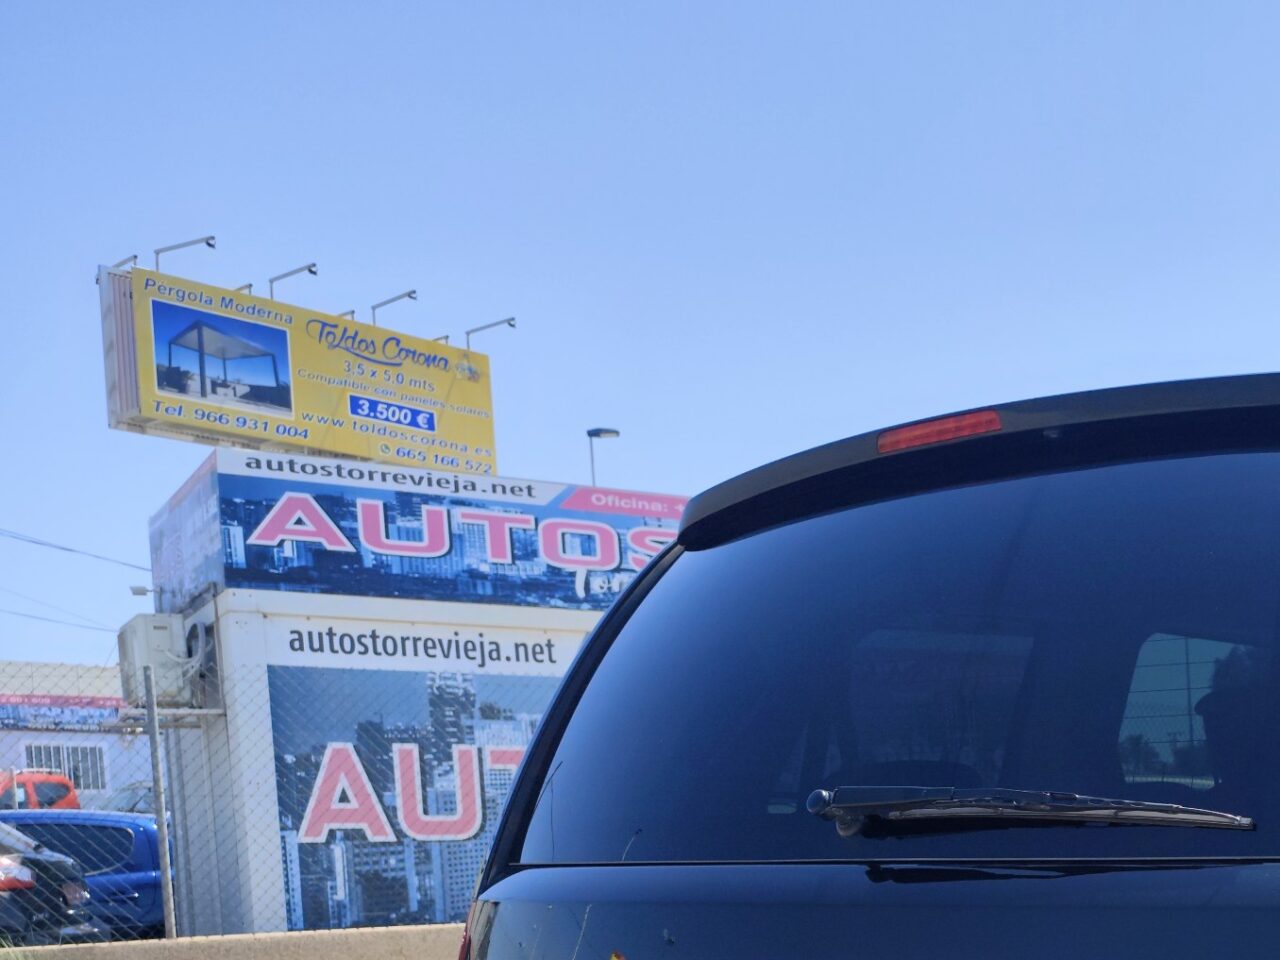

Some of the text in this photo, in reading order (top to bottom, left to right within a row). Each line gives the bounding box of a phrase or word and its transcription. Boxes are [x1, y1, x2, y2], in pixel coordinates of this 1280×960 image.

[220, 296, 293, 325] Moderna
[306, 319, 450, 373] Toldos Corona
[297, 368, 371, 392] Compatible
[374, 386, 397, 398] con
[194, 408, 230, 425] 966
[236, 416, 269, 433] 931
[275, 424, 310, 440] 004
[356, 399, 431, 429] 3.500 €
[396, 446, 493, 475] 665 166 572
[245, 457, 536, 499] autostorrevieja.net
[288, 627, 557, 668] autostorrevieja.net
